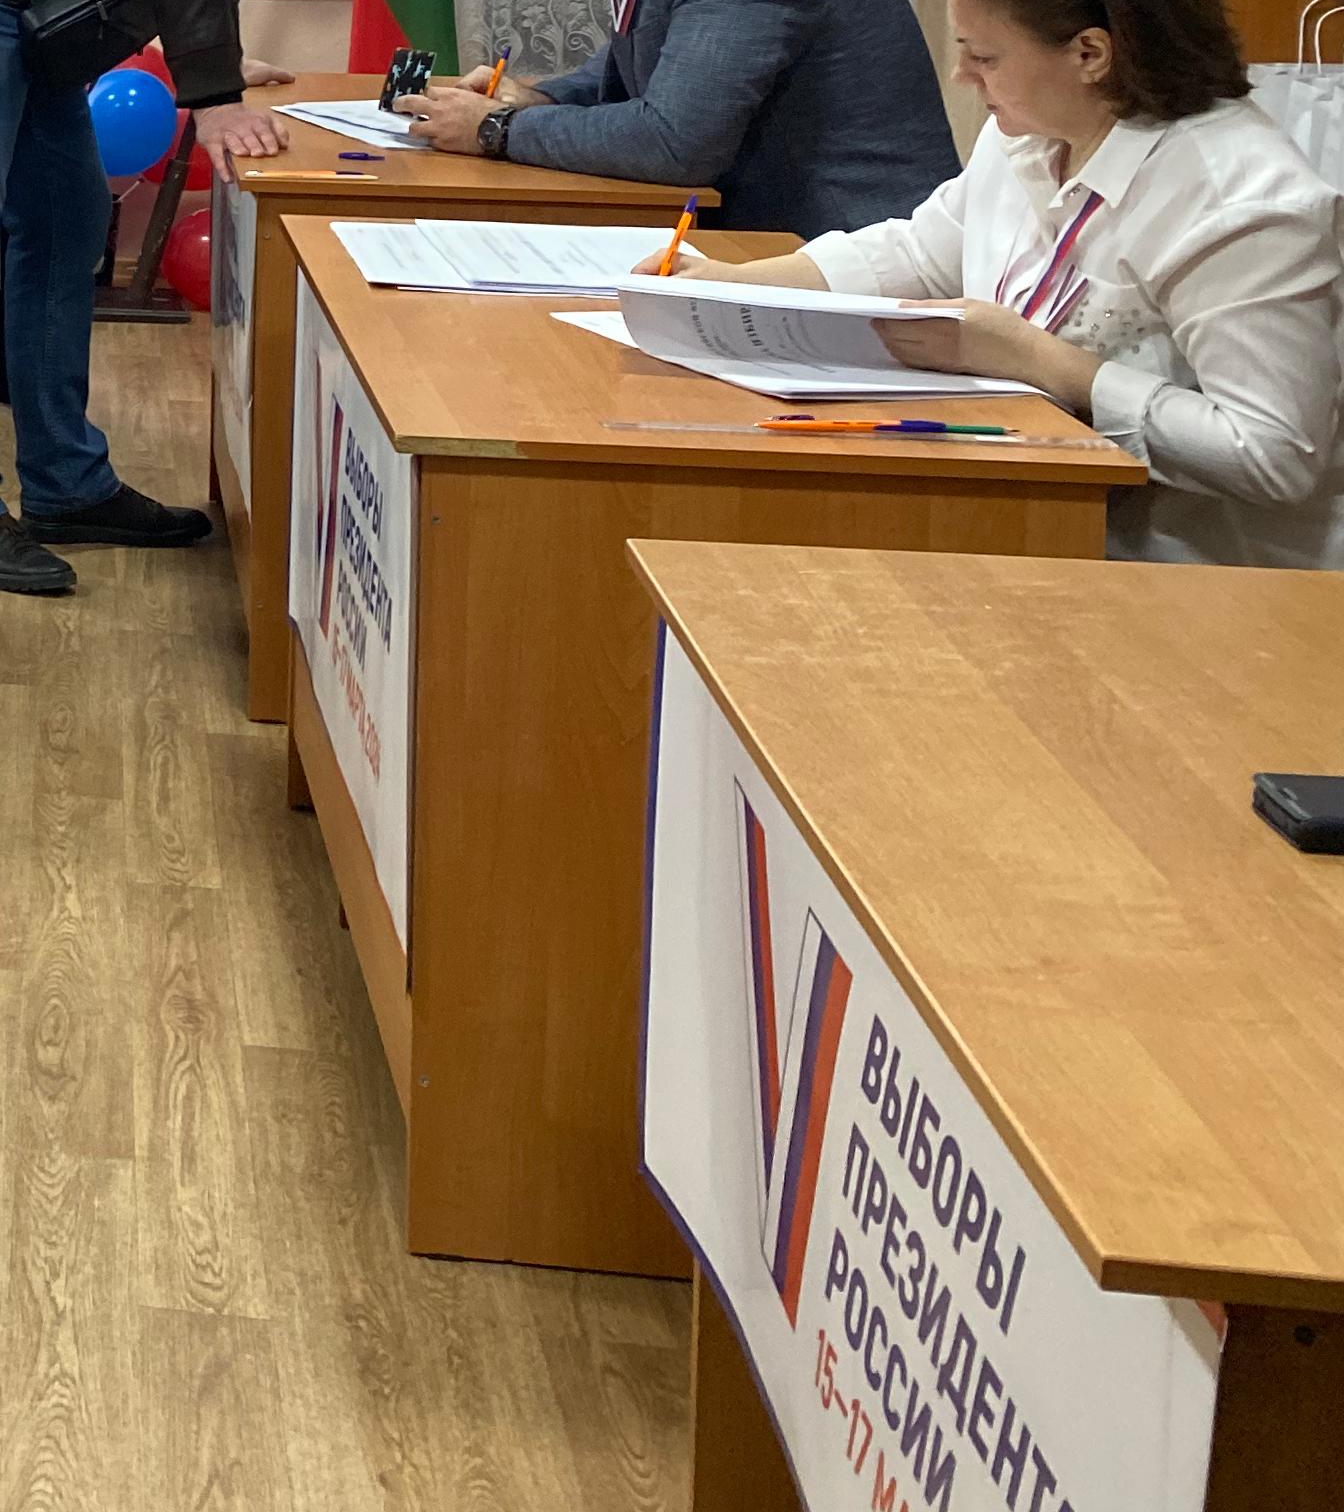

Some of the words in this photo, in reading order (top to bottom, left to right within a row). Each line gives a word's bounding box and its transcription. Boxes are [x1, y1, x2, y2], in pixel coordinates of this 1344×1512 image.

[345, 427, 383, 541] ВЫБОРЫ
[336, 559, 368, 672] РОССИИ
[341, 494, 392, 654] ПРЕЗИДЕНТА
[346, 662, 365, 738] МАРТА
[861, 1013, 1026, 1336] ВЫБОРЫ
[825, 1227, 957, 1512] РОССИИ
[843, 1122, 1075, 1512] ПРЕЗИДЕНТ
